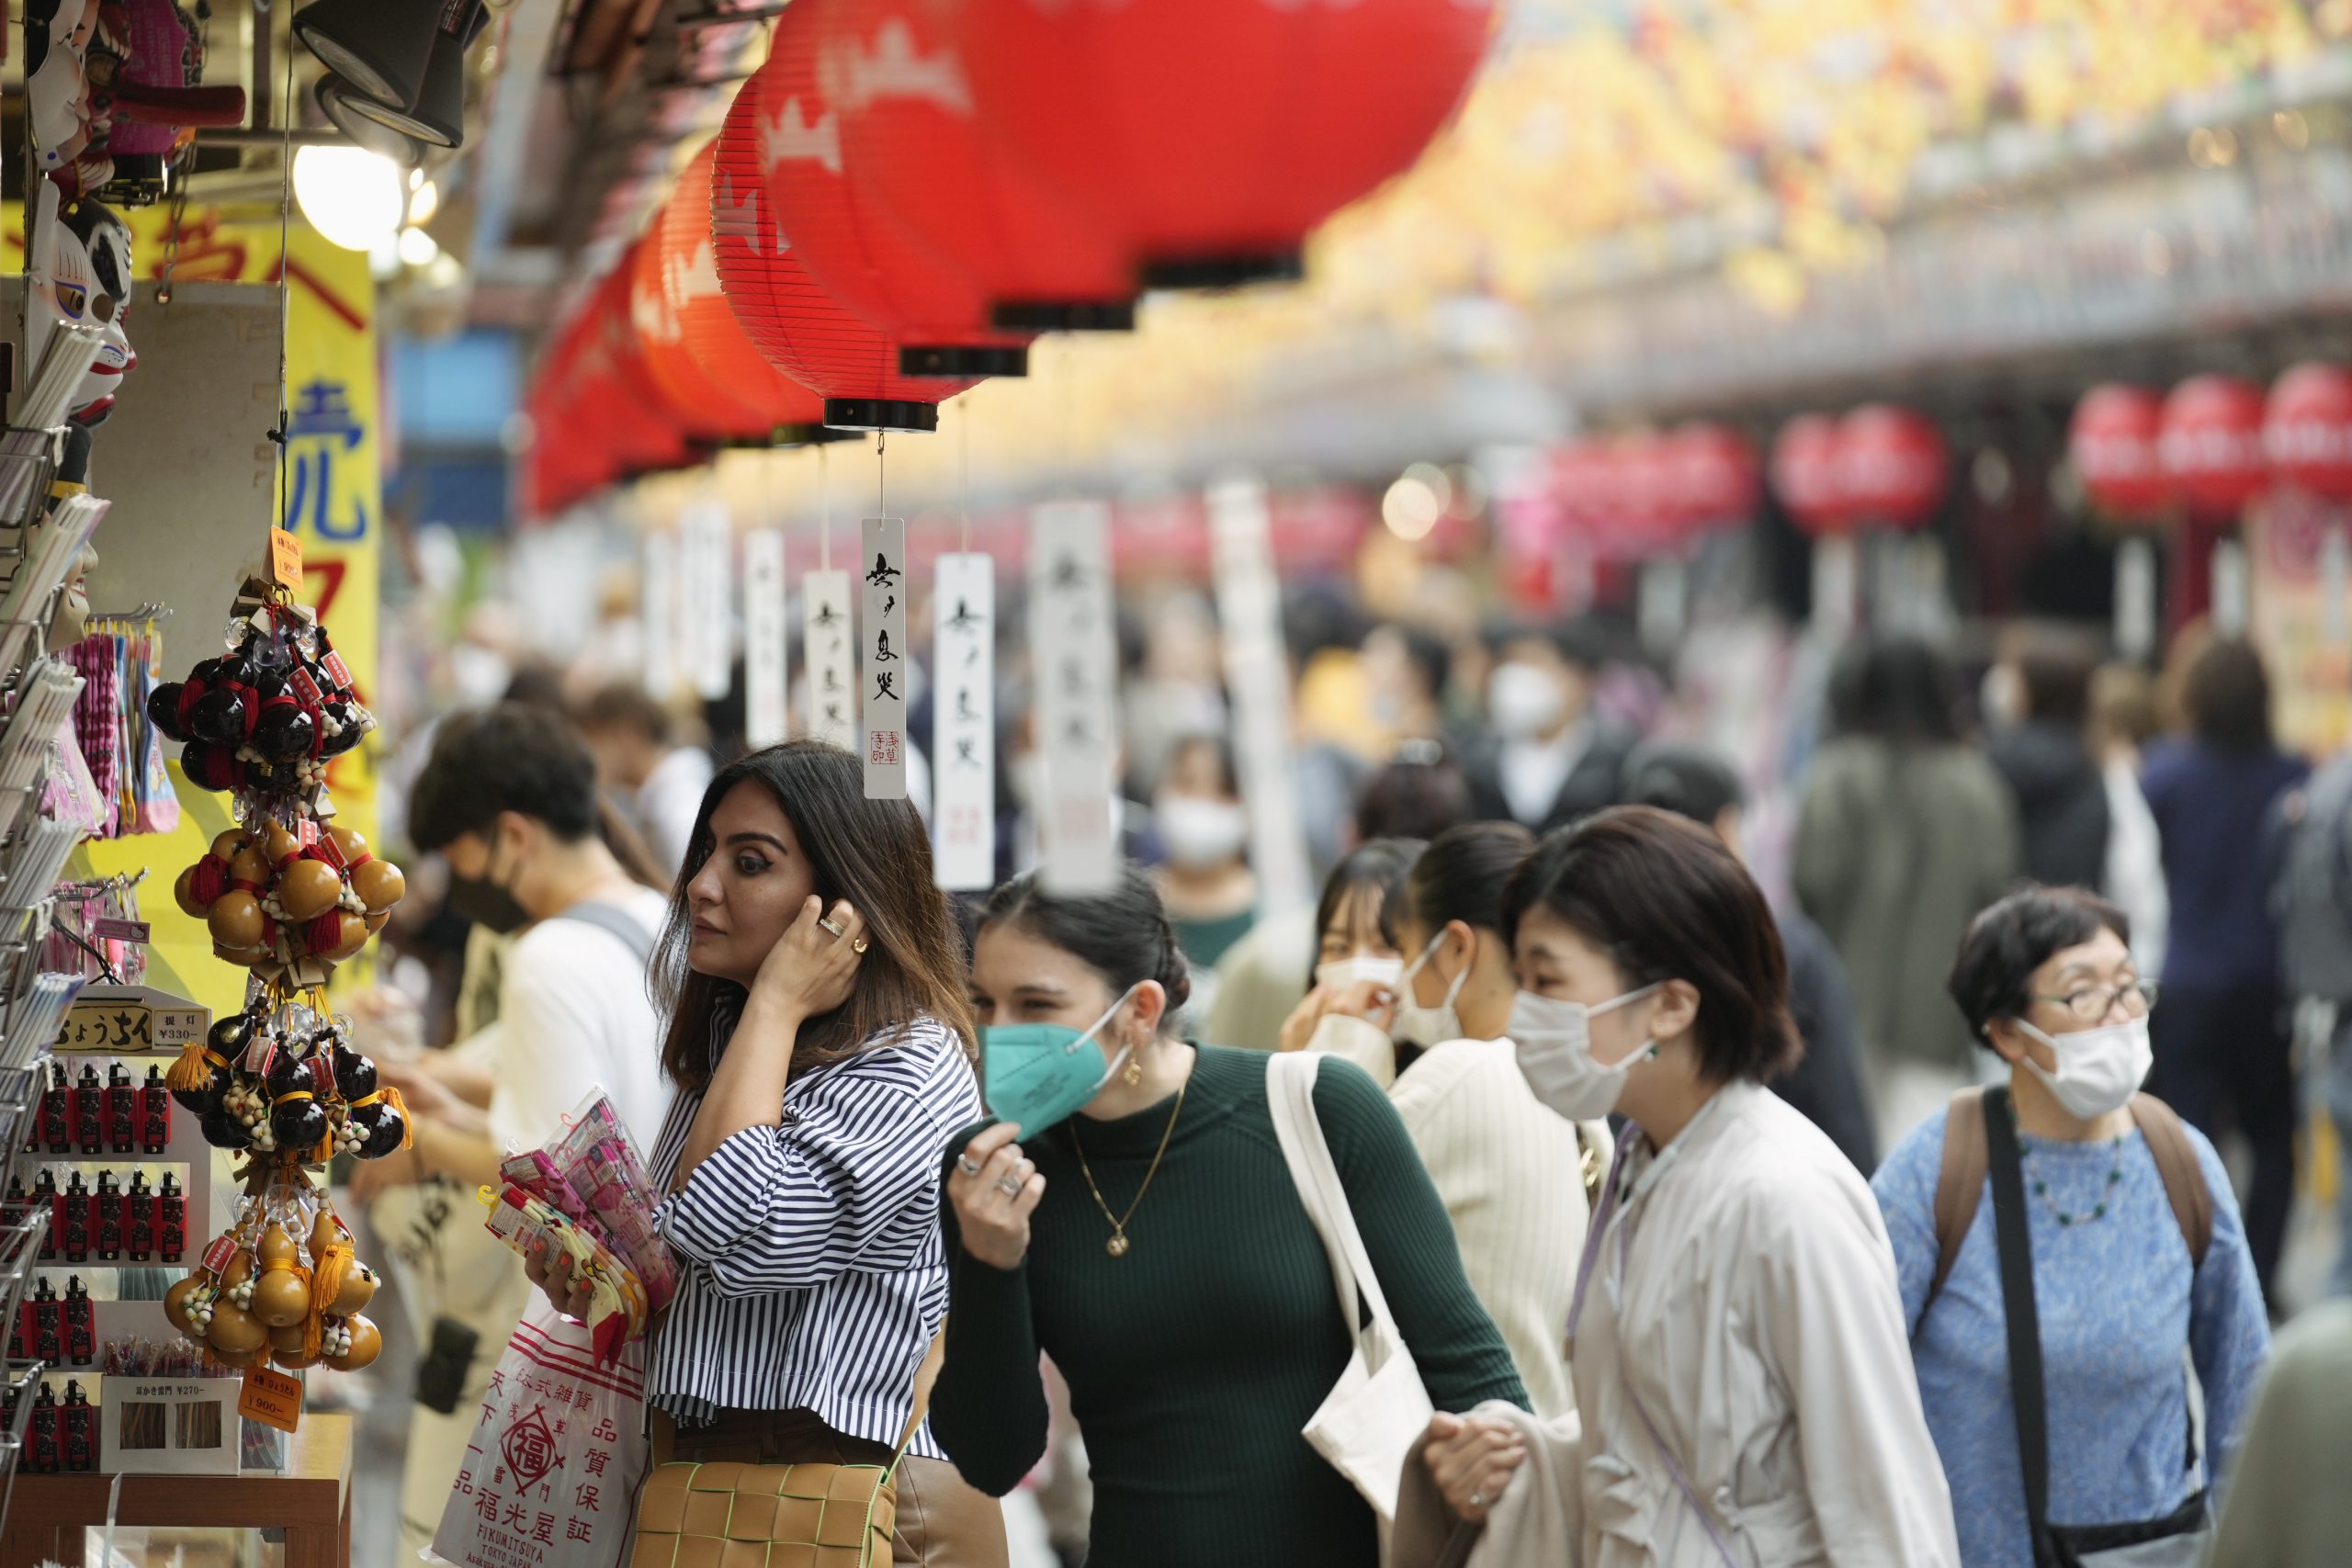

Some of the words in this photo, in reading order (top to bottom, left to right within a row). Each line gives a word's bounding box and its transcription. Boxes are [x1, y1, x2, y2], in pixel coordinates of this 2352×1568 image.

[453, 1370, 505, 1495] 天下一品
[514, 1428, 546, 1472] 福
[475, 1487, 555, 1547] 福光屋
[566, 1417, 617, 1544] 品質保証
